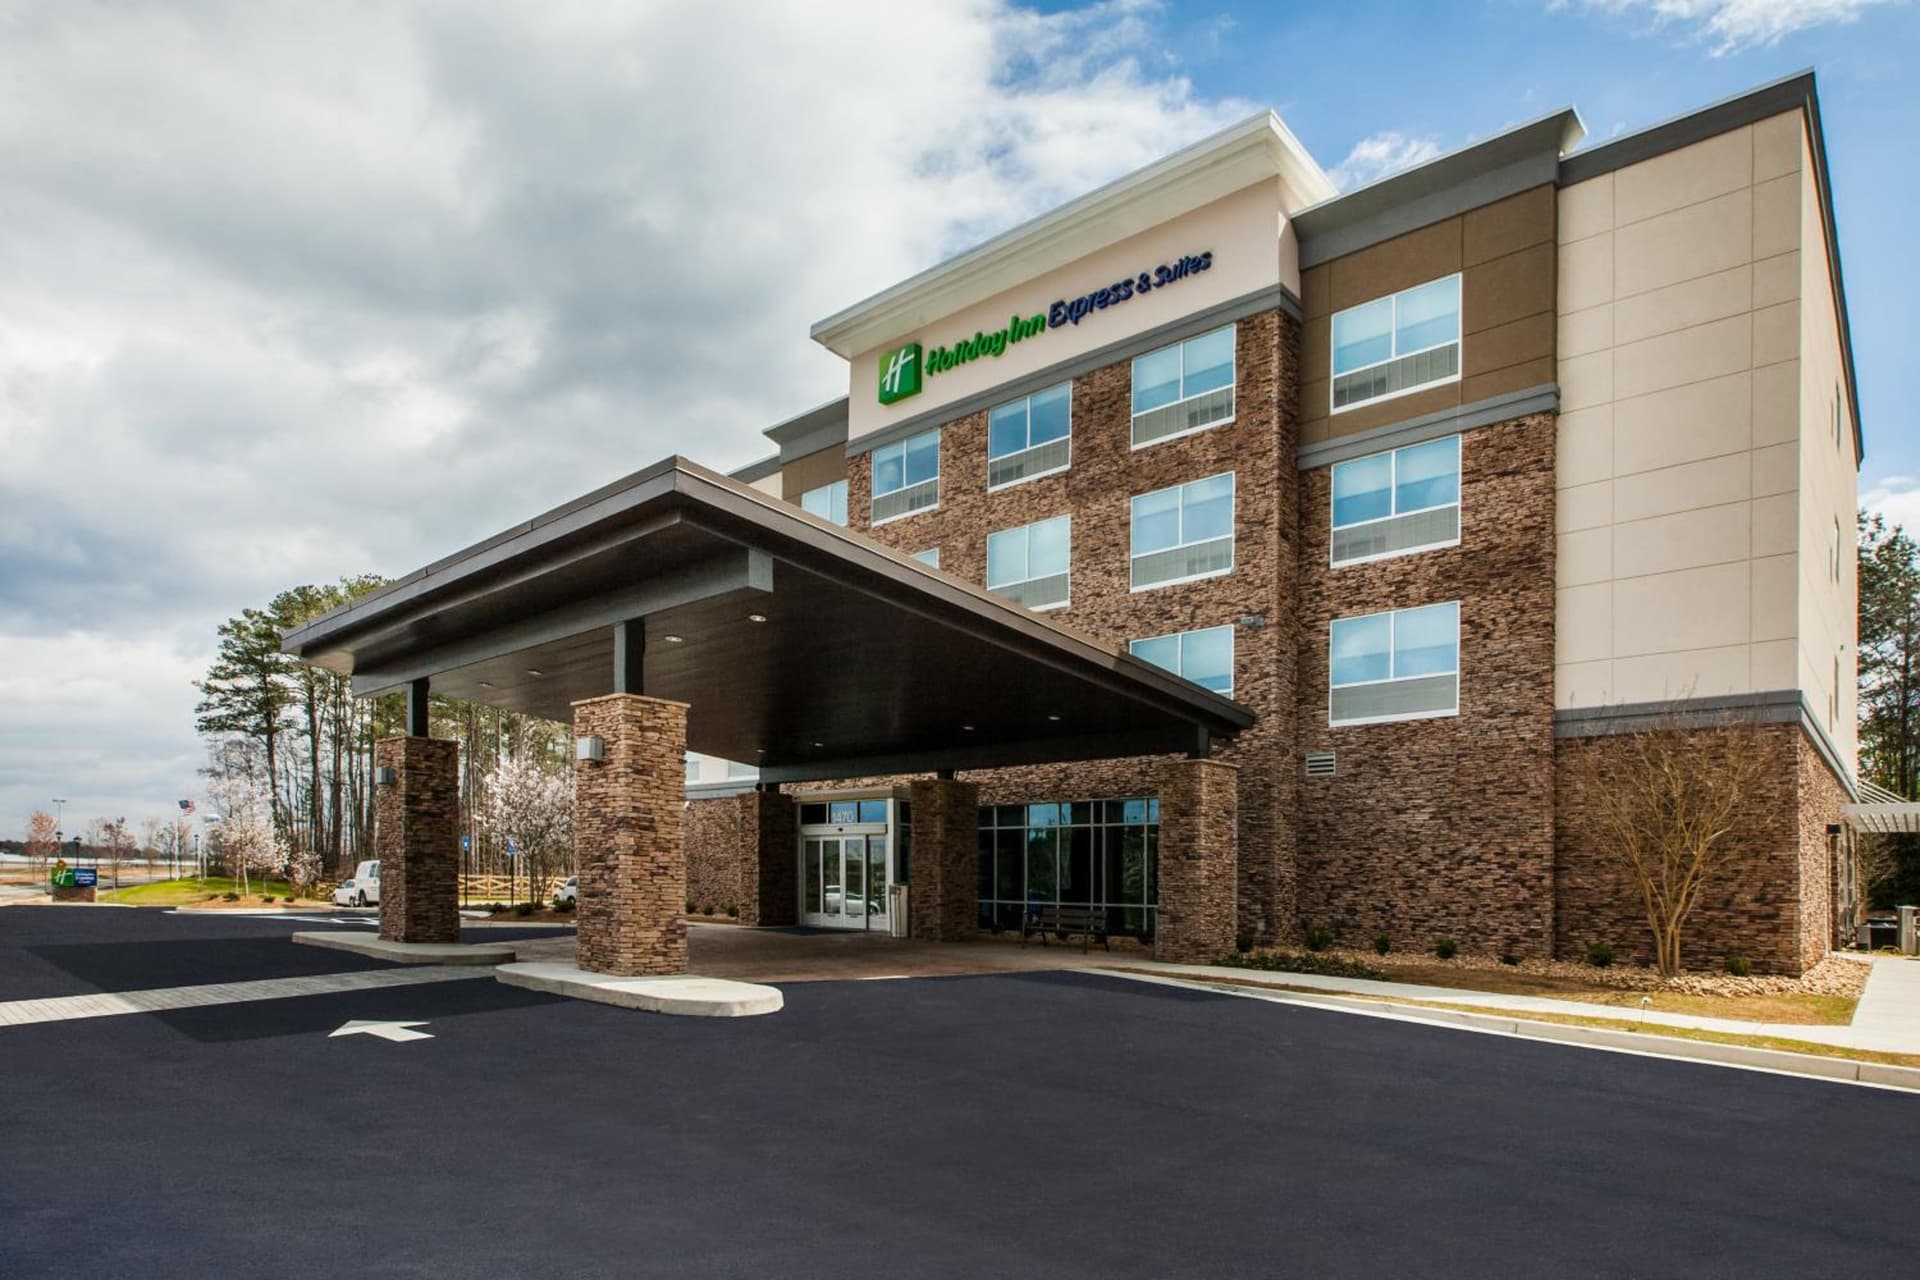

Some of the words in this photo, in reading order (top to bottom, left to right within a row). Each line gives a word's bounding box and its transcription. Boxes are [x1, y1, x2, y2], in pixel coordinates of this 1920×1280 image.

[925, 331, 1008, 376] Holiday
[1008, 314, 1047, 344] Inn
[1048, 278, 1134, 328] Express
[1136, 272, 1151, 294] &
[1153, 251, 1213, 288] Suites
